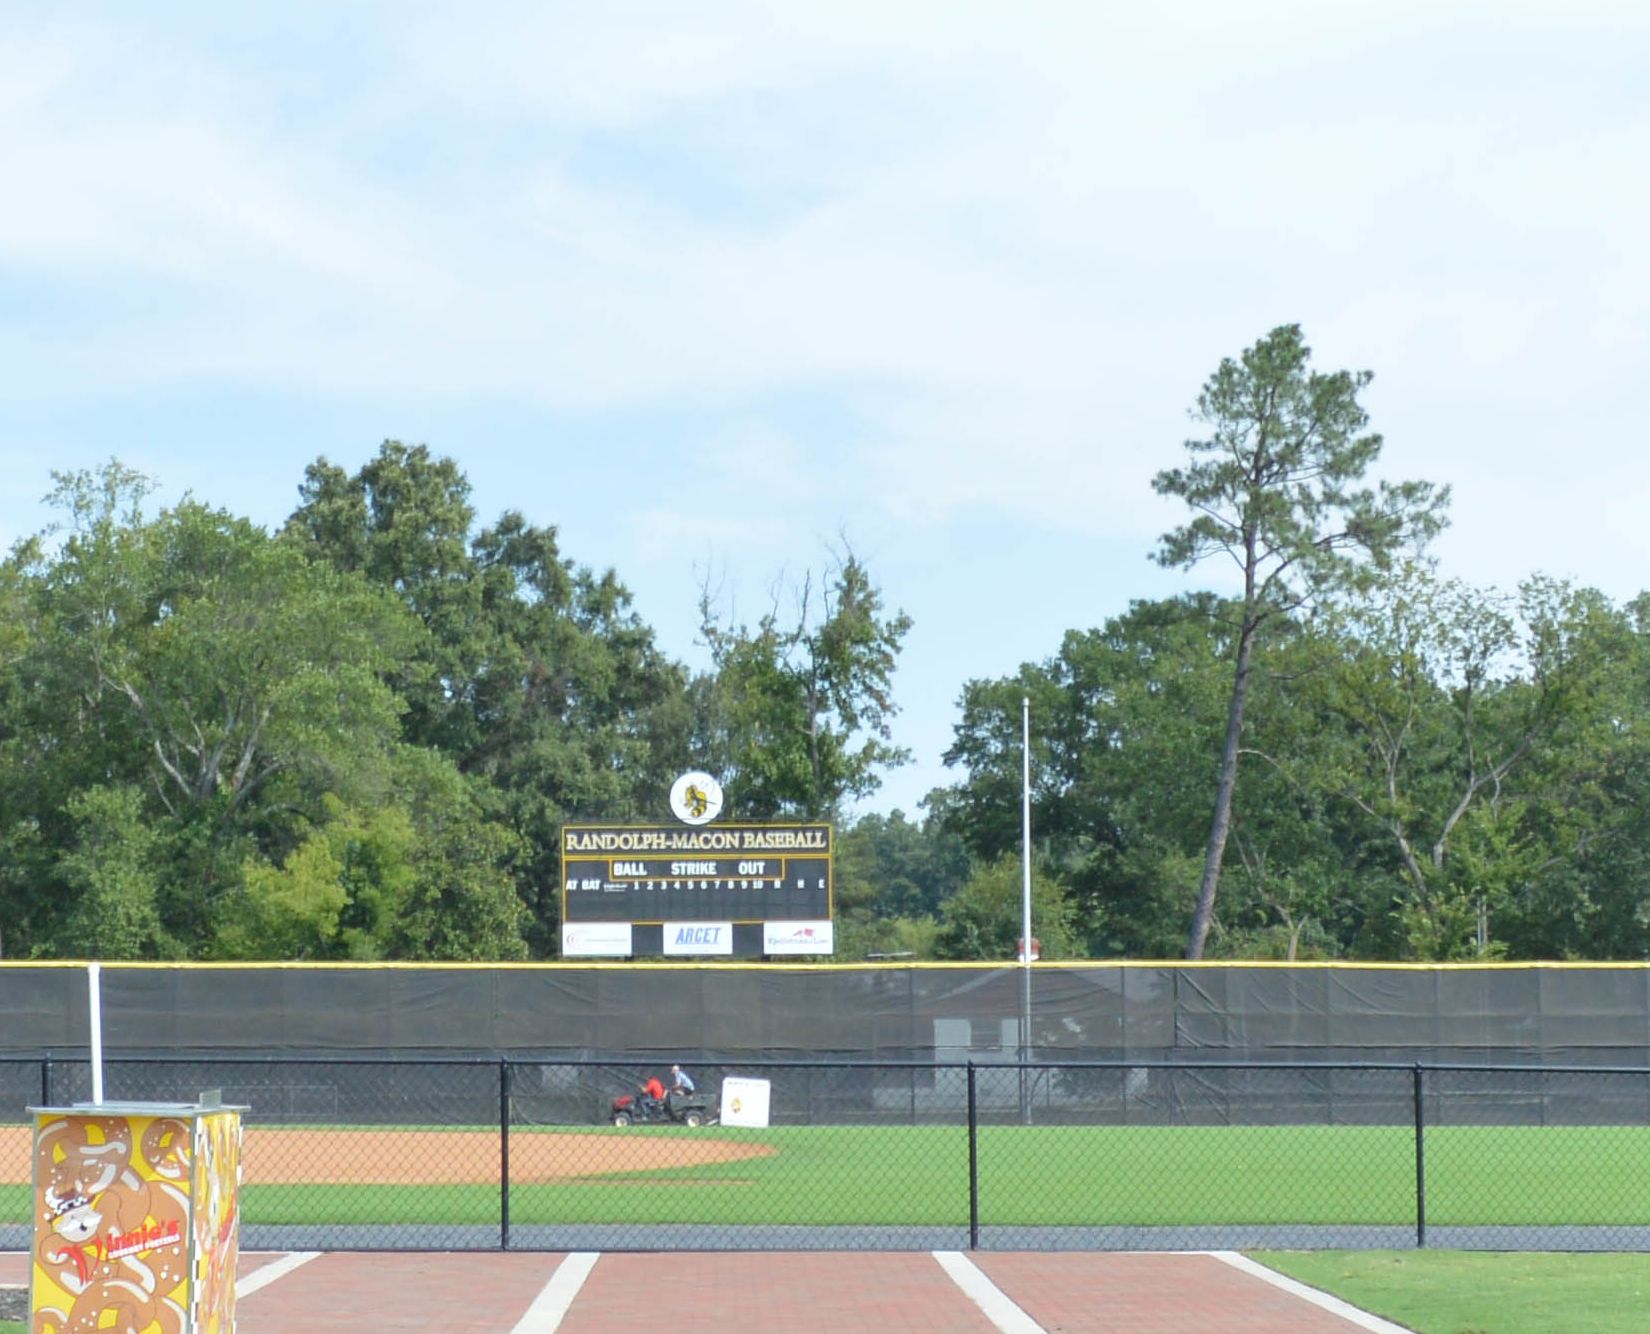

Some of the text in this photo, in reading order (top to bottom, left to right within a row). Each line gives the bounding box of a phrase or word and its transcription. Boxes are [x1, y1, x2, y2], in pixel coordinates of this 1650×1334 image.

[565, 832, 827, 850] RANDOLPH-MACON BASEBALL
[613, 861, 765, 876] BALL STRIKE OUT
[566, 879, 578, 890] AT
[581, 879, 601, 890] BAT
[633, 880, 640, 890] 1
[714, 880, 721, 889] 7
[674, 927, 722, 944] ARCET
